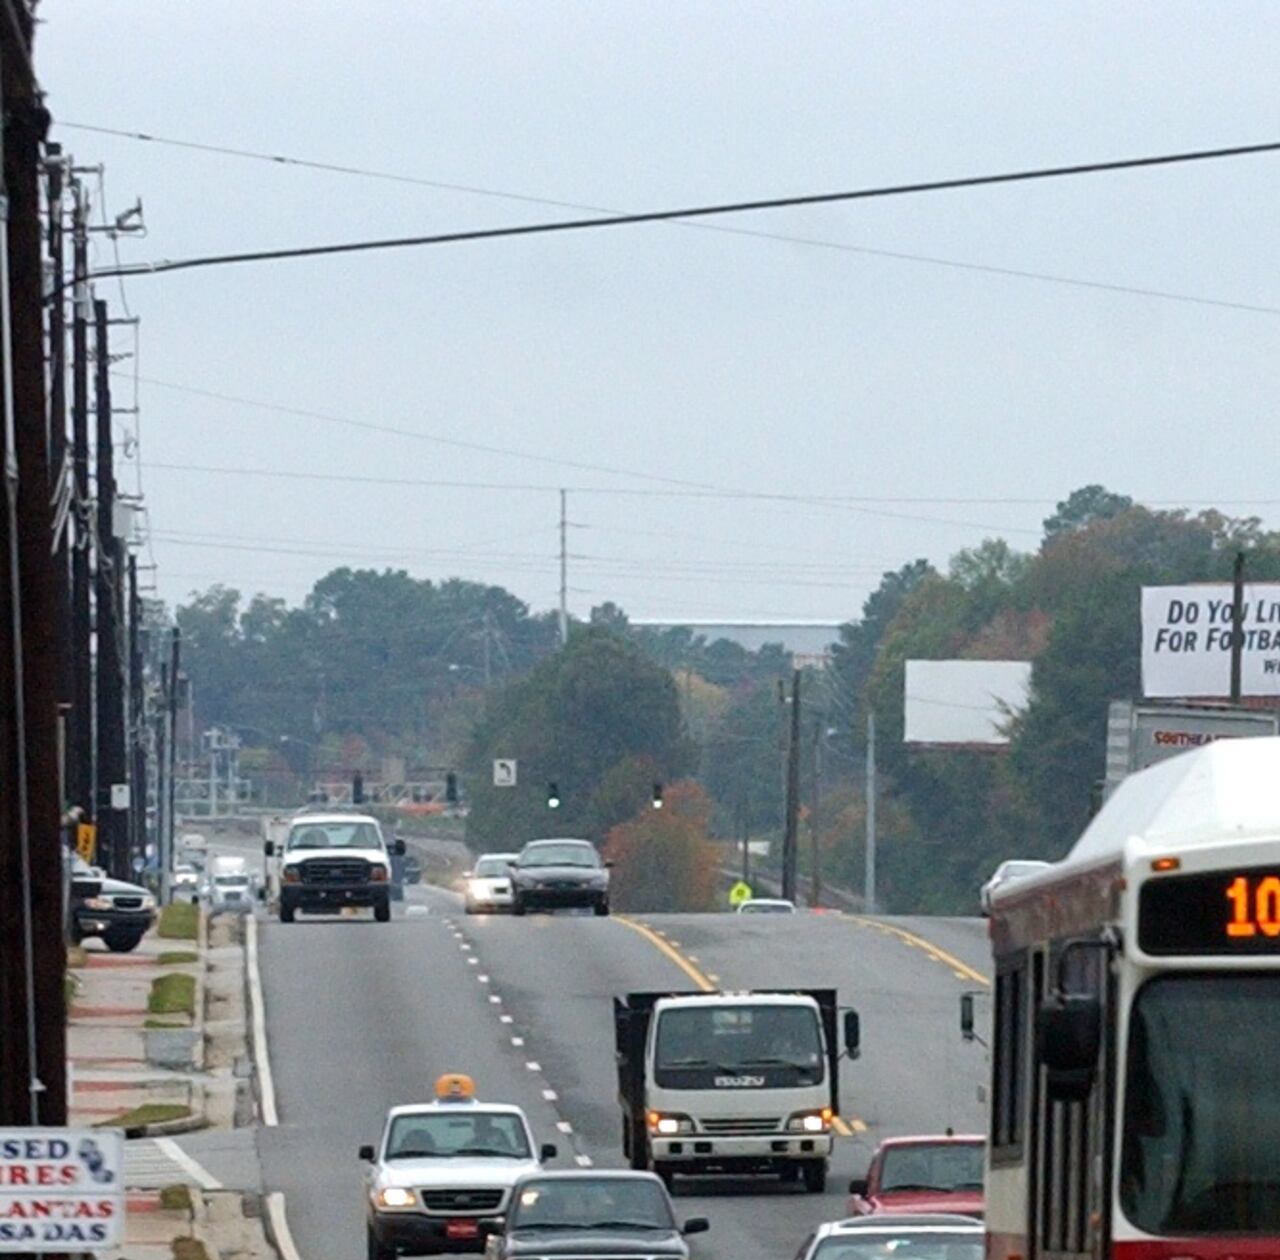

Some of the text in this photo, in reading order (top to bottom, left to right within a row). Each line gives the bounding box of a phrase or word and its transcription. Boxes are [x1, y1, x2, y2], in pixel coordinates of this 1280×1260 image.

[1167, 600, 1199, 624] DO
[1154, 628, 1198, 652] FOR
[0, 1165, 78, 1184] RES
